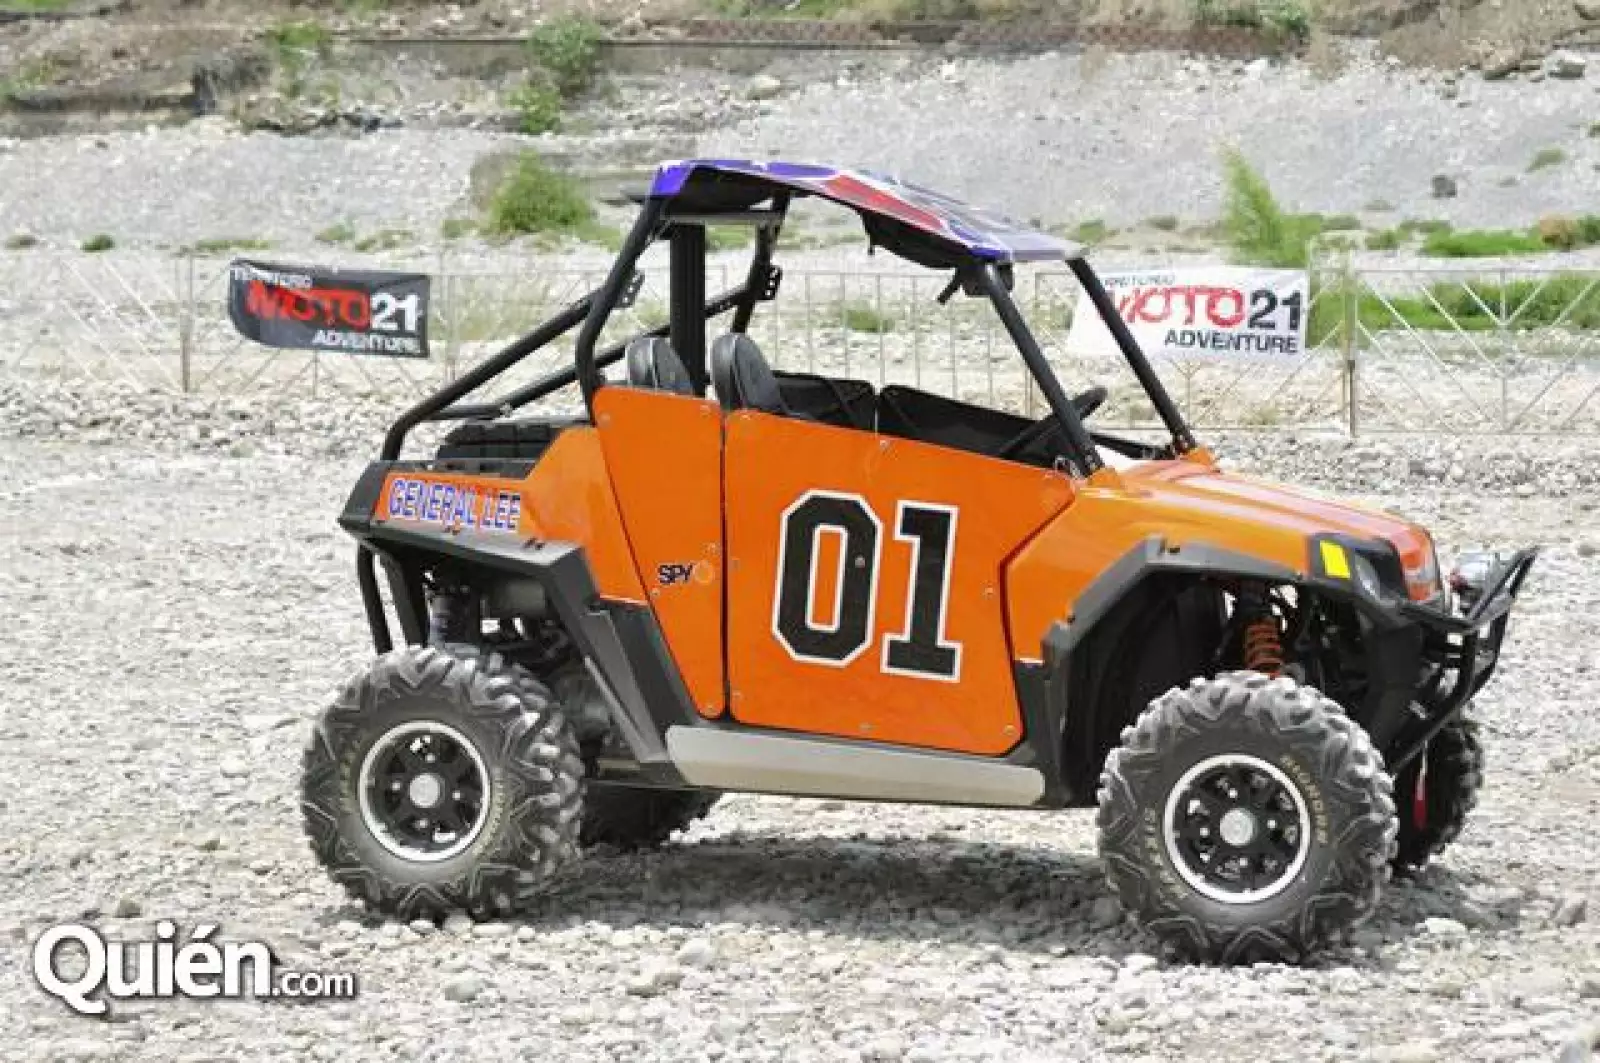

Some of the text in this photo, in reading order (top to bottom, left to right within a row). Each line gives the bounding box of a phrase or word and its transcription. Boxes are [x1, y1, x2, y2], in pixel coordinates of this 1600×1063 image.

[1164, 330, 1299, 354] ADVENTURE
[389, 478, 521, 532] GENERAL LEE
[657, 562, 693, 584] SPY
[772, 488, 963, 683] 01
